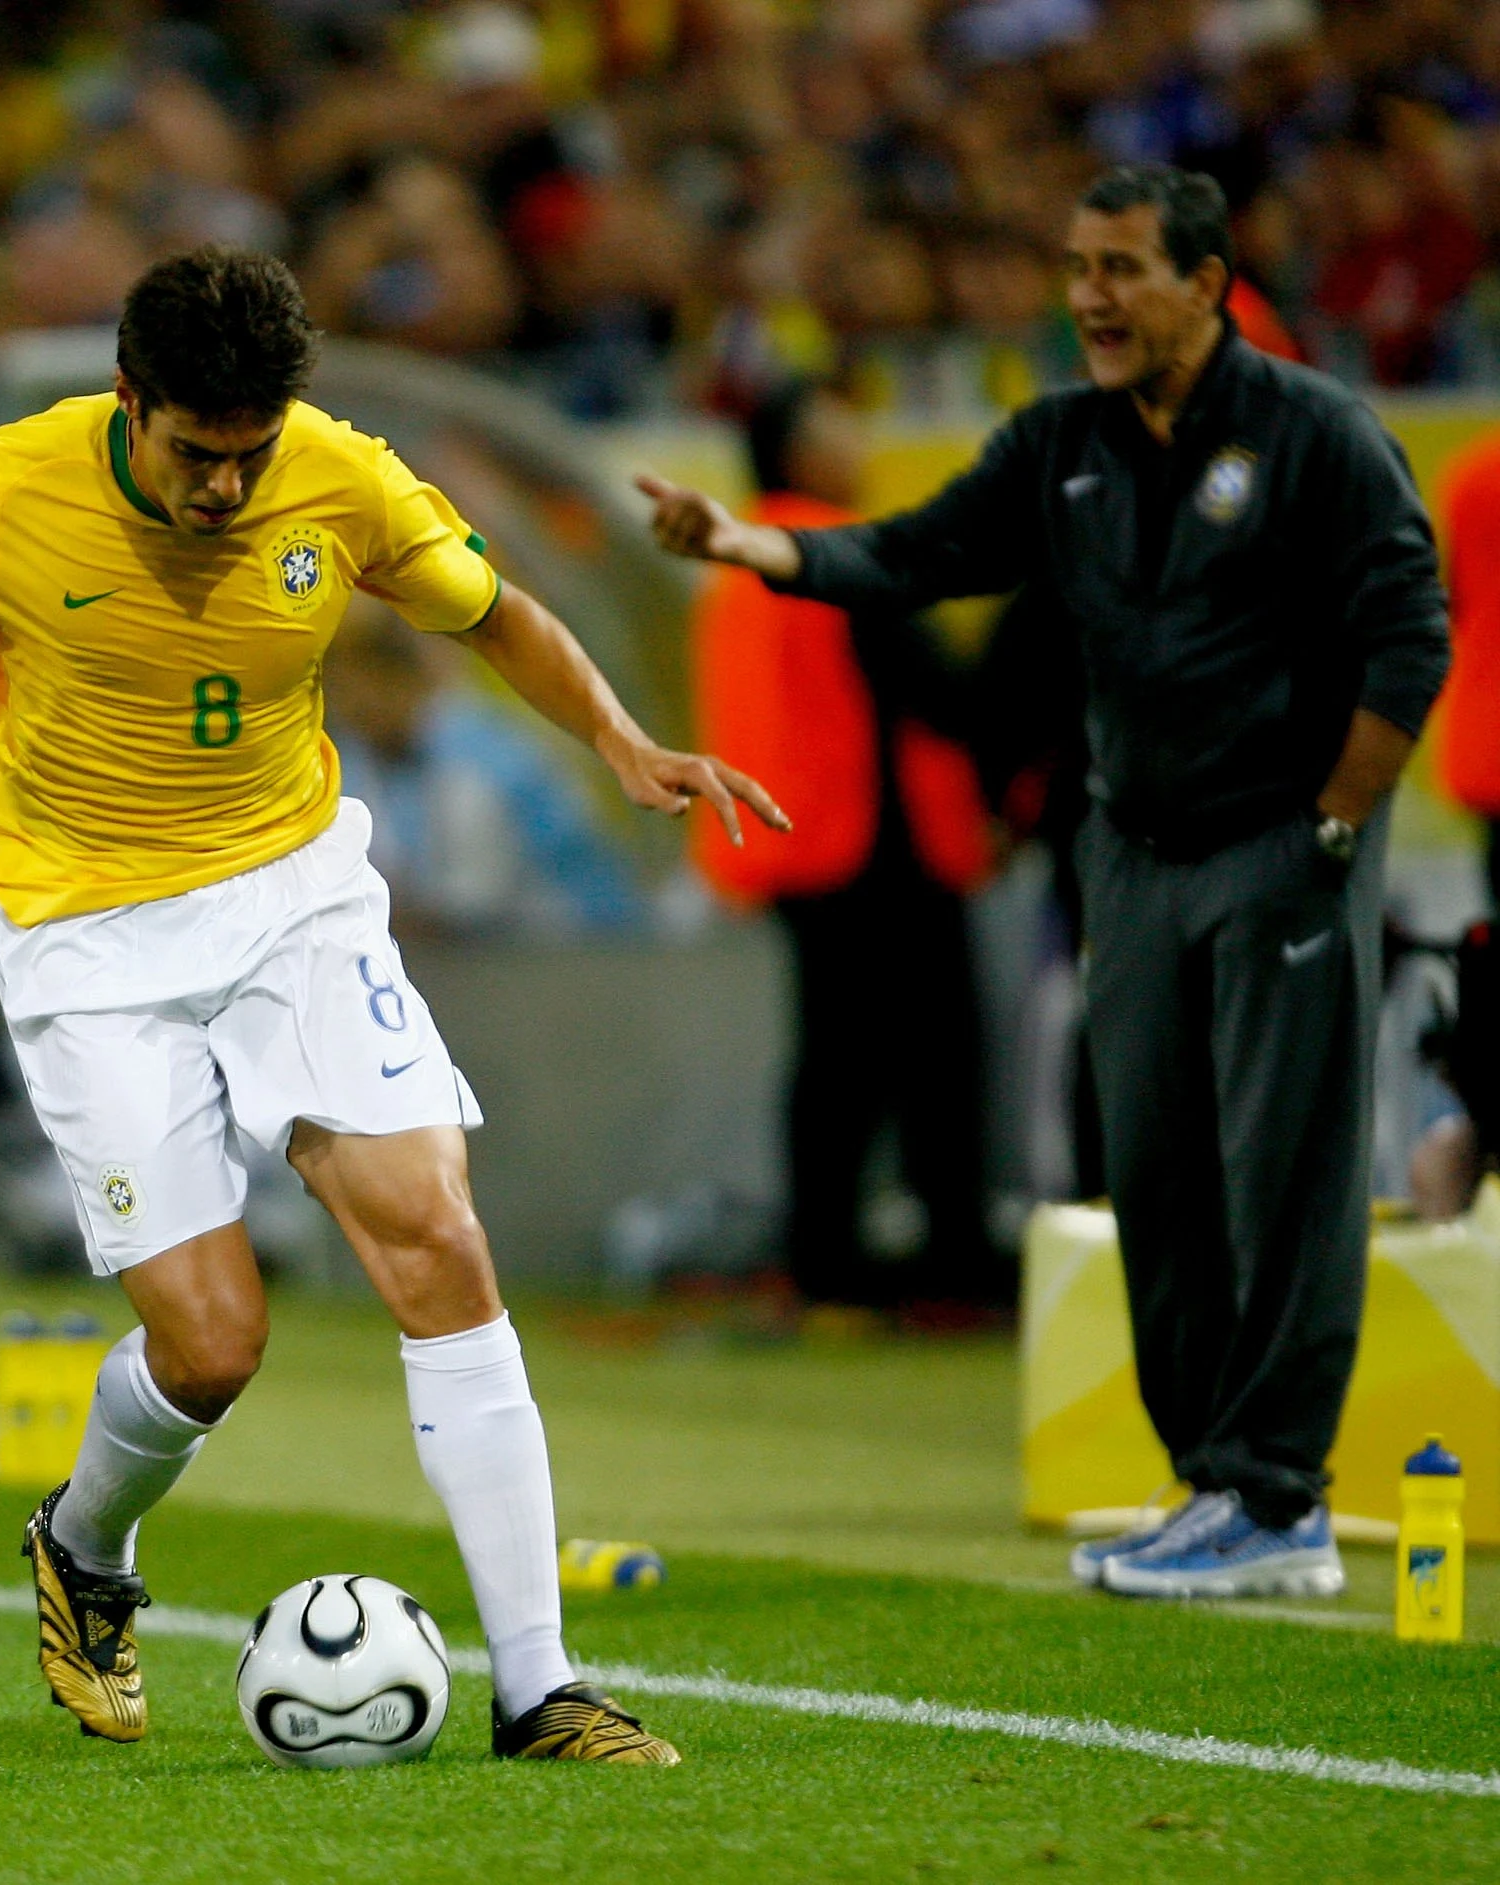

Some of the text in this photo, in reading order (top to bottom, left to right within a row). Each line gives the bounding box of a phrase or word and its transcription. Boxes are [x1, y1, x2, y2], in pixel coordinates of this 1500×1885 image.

[190, 672, 243, 749] 8
[355, 954, 407, 1035] 8
[85, 1609, 99, 1648] adidas
